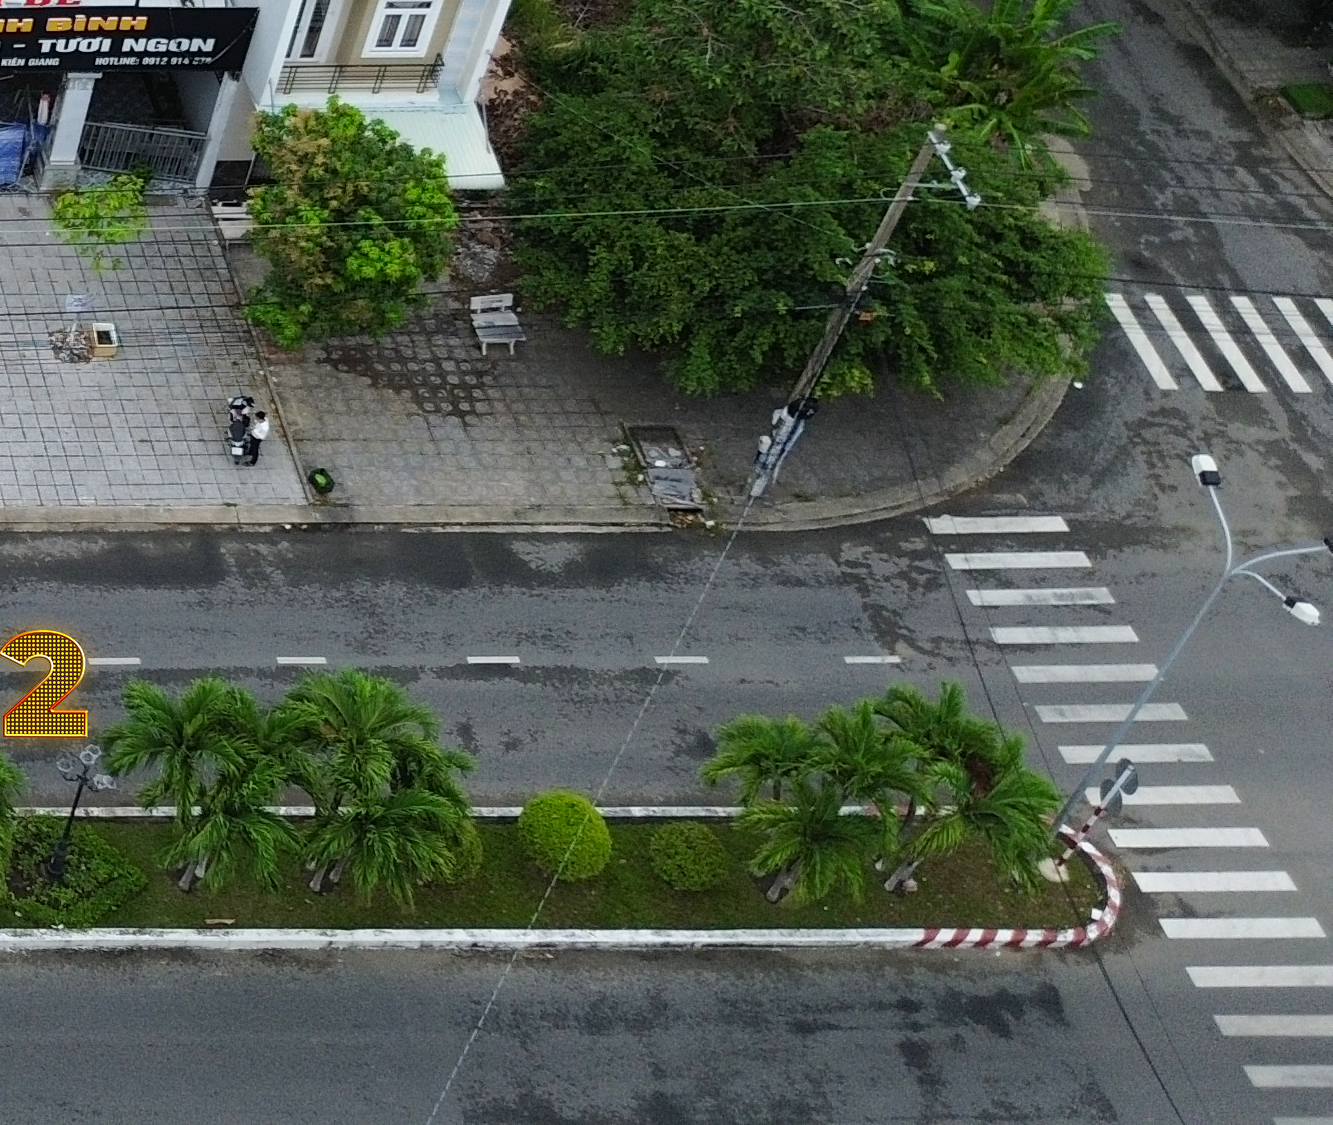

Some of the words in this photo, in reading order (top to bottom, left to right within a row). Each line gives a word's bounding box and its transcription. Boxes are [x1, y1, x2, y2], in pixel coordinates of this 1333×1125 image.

[45, 14, 149, 32] BÌNH
[37, 36, 113, 54] TƯƠI
[120, 37, 216, 53] NGON
[0, 56, 26, 67] KIÊN
[27, 57, 60, 67] GIANG
[94, 56, 141, 66] HOTLINE:
[141, 56, 167, 66] 0912
[170, 56, 190, 66] 914
